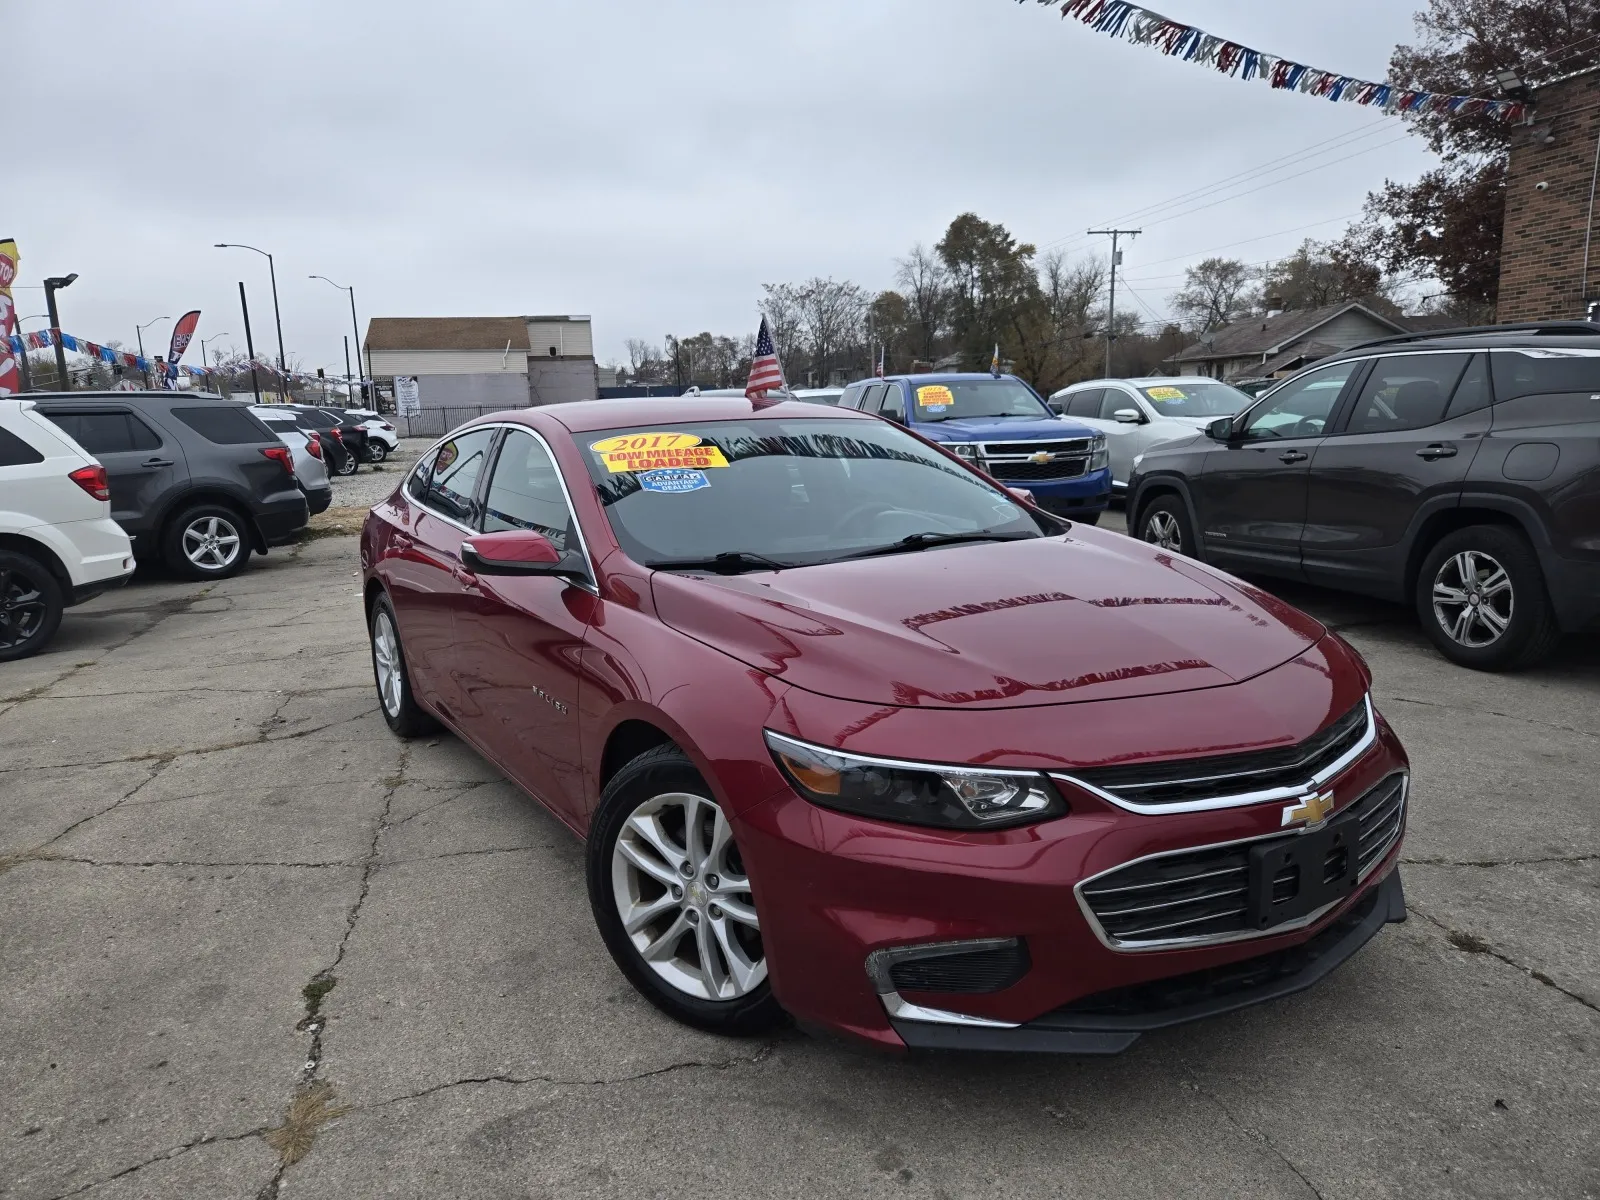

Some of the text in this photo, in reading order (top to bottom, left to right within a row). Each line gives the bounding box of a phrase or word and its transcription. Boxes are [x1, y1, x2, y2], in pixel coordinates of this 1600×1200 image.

[612, 435, 682, 451] 2017
[609, 447, 715, 462] LOW MILEAGE
[627, 457, 712, 469] LOADED
[643, 473, 701, 482] CARFAX
[651, 479, 700, 487] ADVANTAGE
